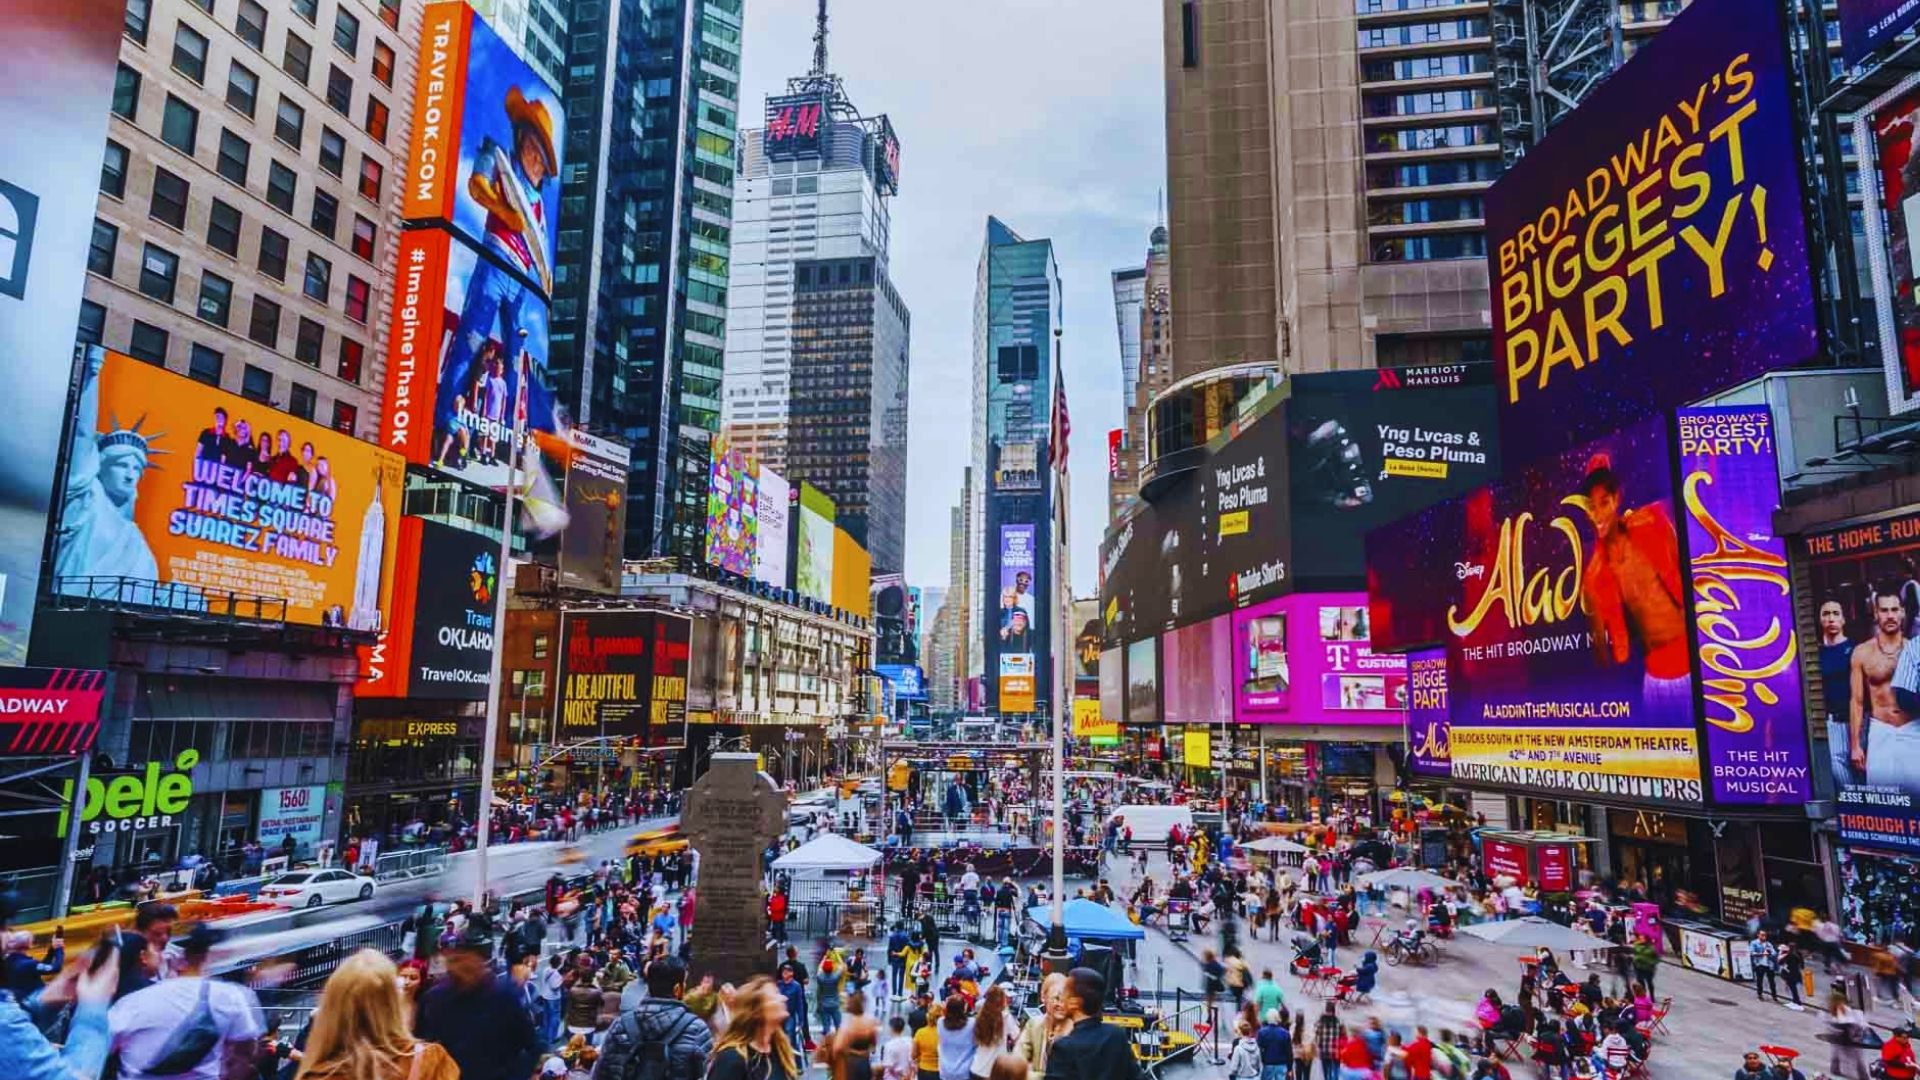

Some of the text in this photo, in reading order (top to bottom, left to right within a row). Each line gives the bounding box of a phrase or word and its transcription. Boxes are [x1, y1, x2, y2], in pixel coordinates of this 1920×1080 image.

[417, 20, 450, 200] TRAVELOK.COM
[1501, 52, 1755, 277] BROADWAY'S
[1502, 99, 1757, 333] BIGGEST
[1506, 184, 1774, 404] PARTY!
[1406, 365, 1467, 377] MARRIOTT
[1406, 375, 1461, 386] MARQUIS
[1679, 413, 1769, 425] BROADWAY'S
[1378, 425, 1480, 446] Yng Lvcas &
[1680, 422, 1769, 439] BIGGEST
[1383, 443, 1486, 464] Peso Pluma
[1682, 437, 1771, 456] PARTY!
[1216, 467, 1231, 490] Yng
[1257, 456, 1265, 477] &
[193, 458, 334, 517] WELCOME TO
[1219, 485, 1268, 511] Peso Pluma
[183, 484, 335, 543] TIMES SQUARE
[169, 510, 339, 567] SUAREZ FAMILY
[1807, 536, 1835, 555] THE
[1462, 647, 1483, 660] THE
[1486, 643, 1504, 660] HIT
[1507, 633, 1582, 657] BROADWAY
[565, 673, 637, 700] A BEAUTIFUL
[564, 700, 598, 726] NOISE
[408, 722, 457, 735] EXPRESS
[1458, 733, 1485, 744] BLOCKS
[1486, 733, 1511, 745] SOUTH
[1514, 734, 1524, 745] AT
[1526, 734, 1542, 746] THE
[1544, 734, 1566, 747] NEW
[1568, 735, 1632, 749] AMSTERDAM
[1634, 736, 1693, 754] THEATRE,
[1528, 750, 1546, 761] AND
[1563, 752, 1602, 765] AVENUE
[1727, 751, 1790, 762] THE HIT
[1453, 762, 1702, 802] AMERICAN EAGLE OUTFITTERS
[1714, 765, 1807, 780] BROADWAY
[1726, 781, 1798, 794] MUSICAL
[279, 789, 306, 808] 1560
[1839, 791, 1911, 807] JESSE WILLIAMS
[89, 815, 173, 834] SOCCER
[1839, 813, 1905, 834] THROUGH
